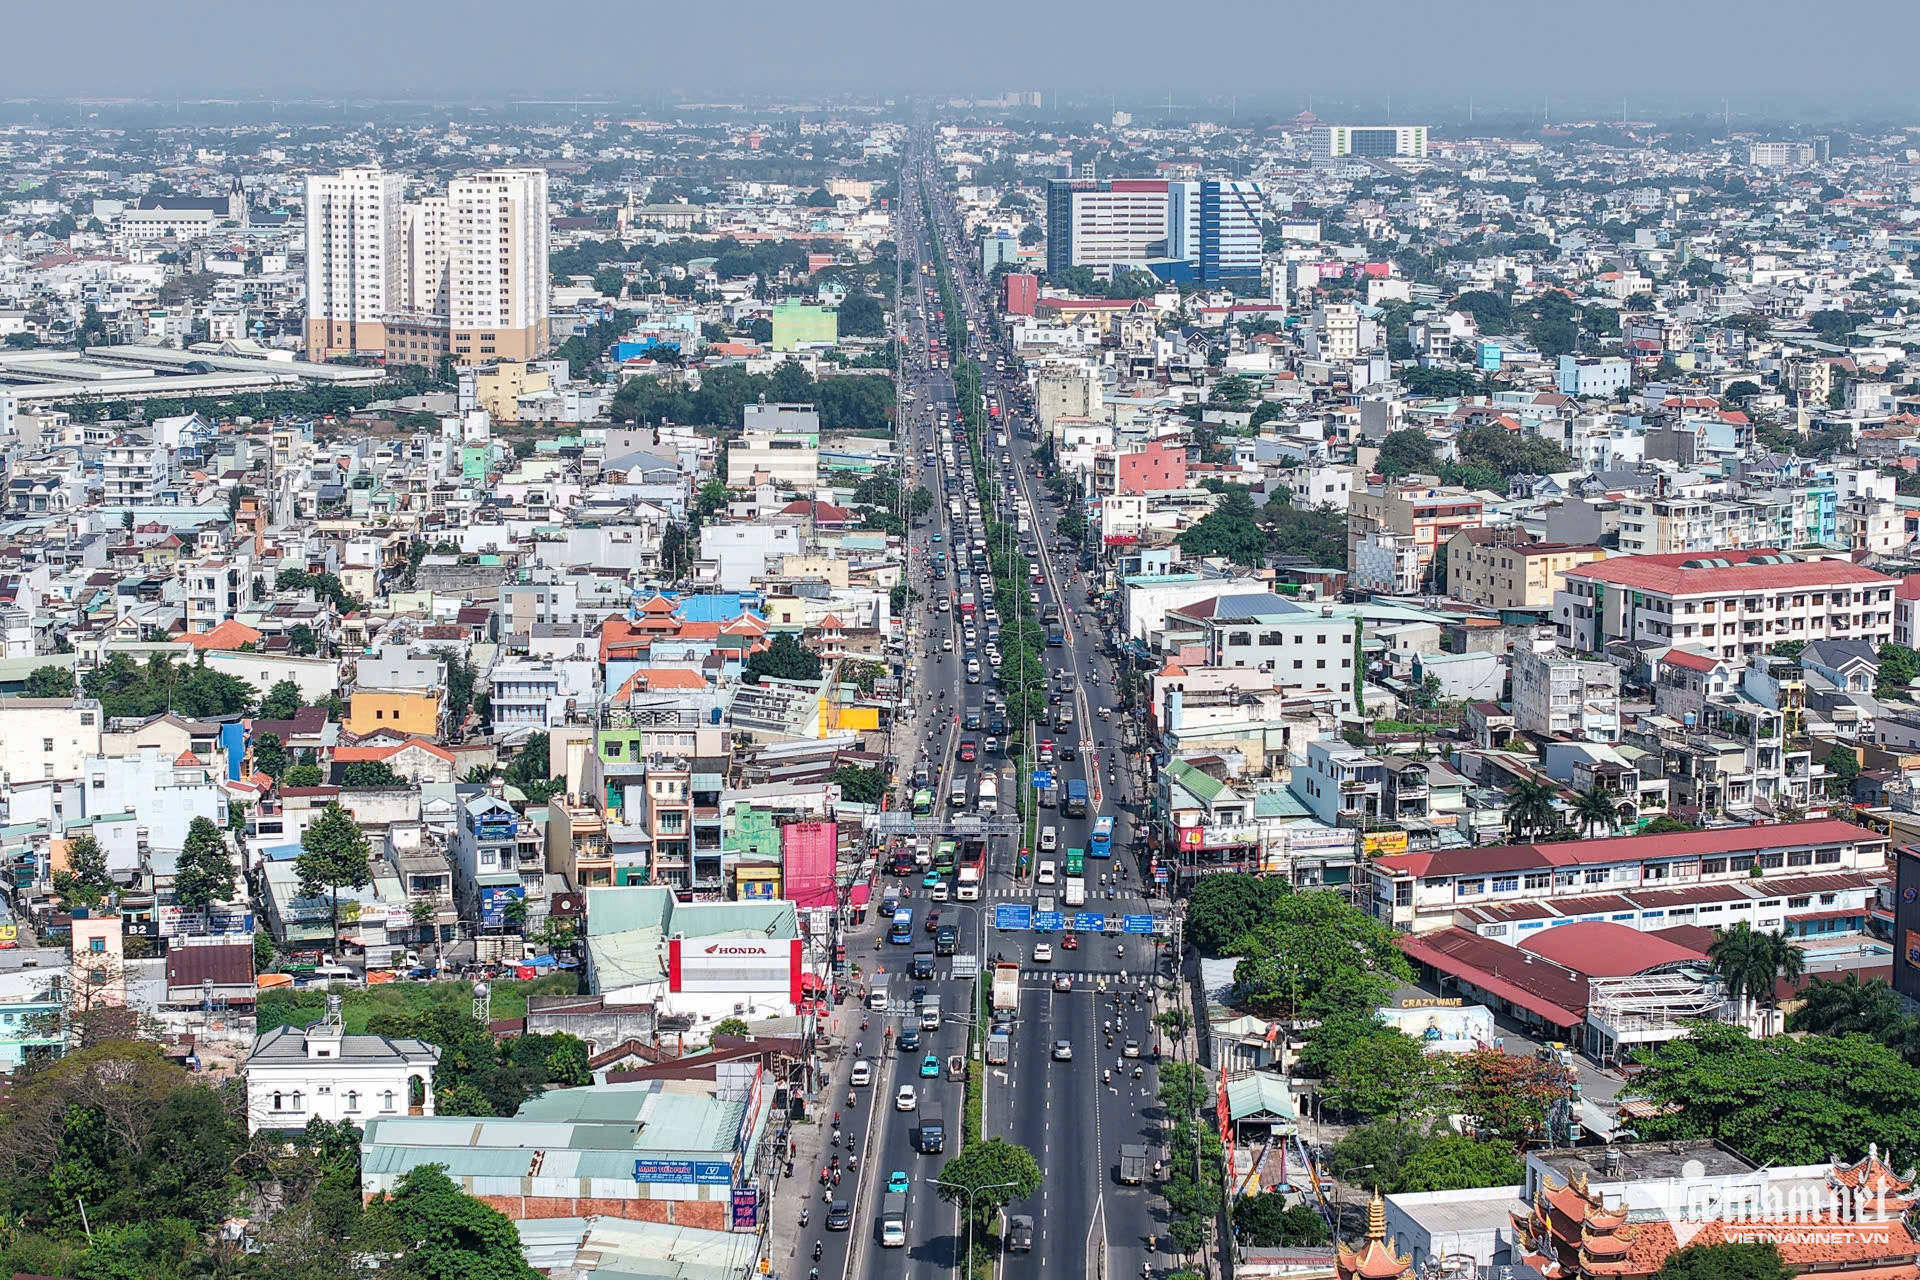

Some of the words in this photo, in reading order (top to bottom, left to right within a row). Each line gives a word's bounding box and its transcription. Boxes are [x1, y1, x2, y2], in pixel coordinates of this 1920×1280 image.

[129, 925, 147, 934] B2
[1402, 999, 1435, 1007] CRAZY
[1436, 998, 1462, 1006] WAVE
